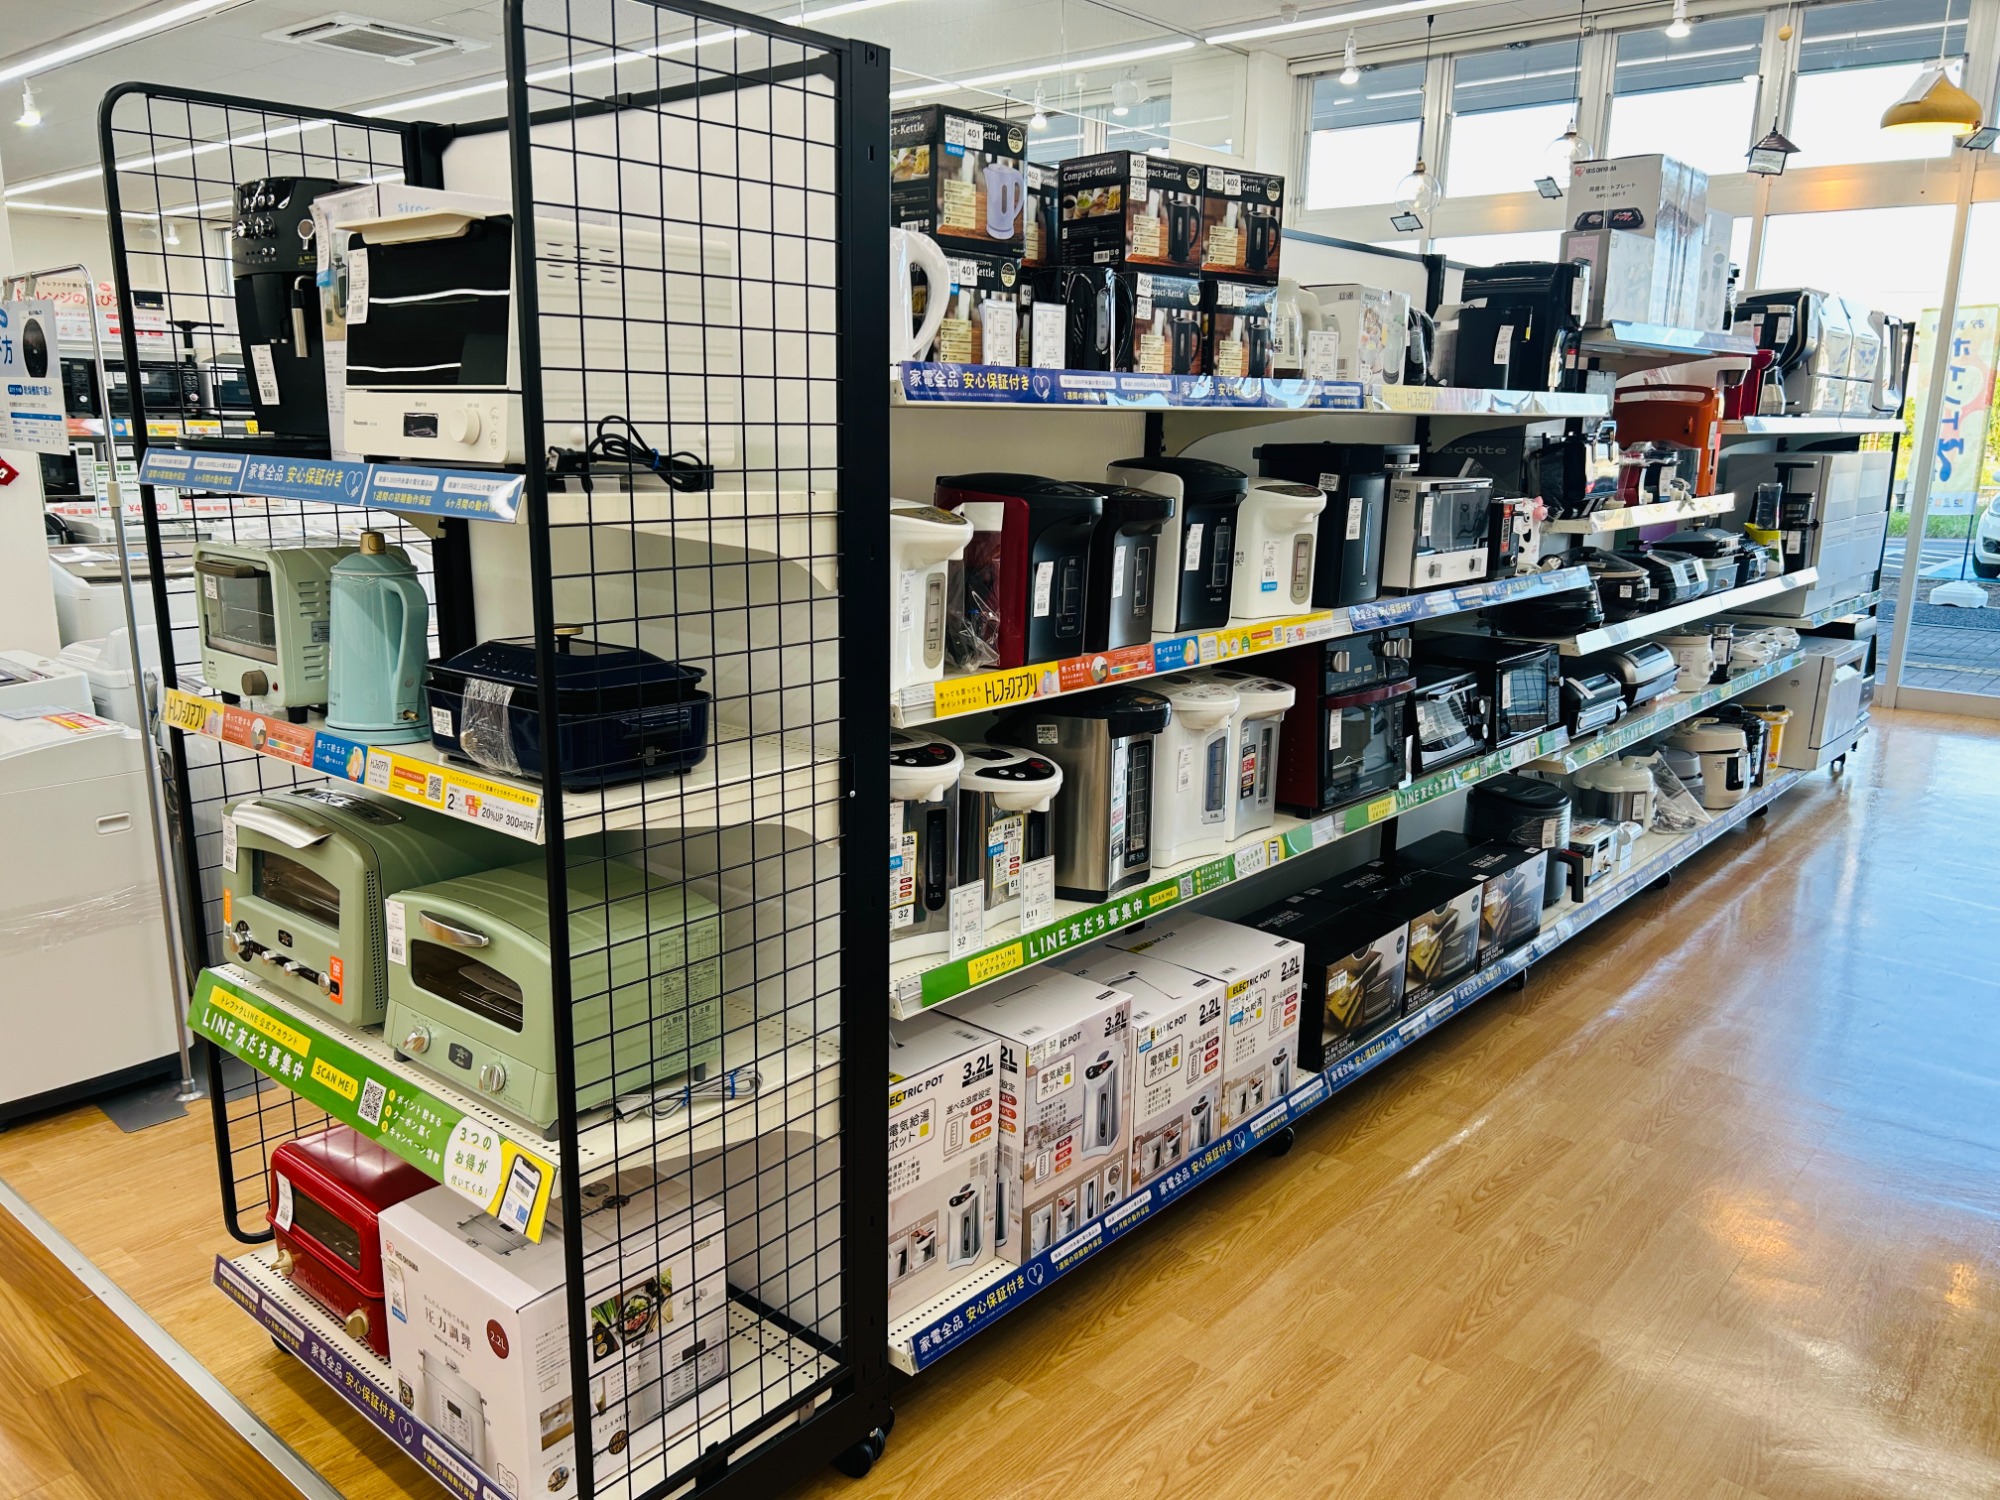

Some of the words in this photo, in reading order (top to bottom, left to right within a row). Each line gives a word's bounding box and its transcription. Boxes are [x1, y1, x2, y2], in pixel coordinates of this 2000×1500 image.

[967, 128, 981, 139] 401
[1063, 165, 1118, 182] Compact-Kettle
[1132, 159, 1145, 169] 402
[1226, 178, 1239, 187] 402
[961, 265, 976, 276] 401
[1139, 277, 1151, 289] 402
[909, 369, 959, 388] 家電全品
[963, 372, 1030, 390] 安心保証付き
[248, 463, 284, 482] 家電全品
[286, 466, 344, 488] 安心保証付き
[985, 671, 1038, 705] トレファクアプリ
[168, 697, 207, 729] トレファクアプリ
[481, 806, 504, 824] 20%UP
[898, 909, 909, 919] 32
[1026, 909, 1038, 919] 611
[957, 936, 967, 947] 32
[1281, 956, 1300, 976] 2.2L
[1232, 975, 1259, 995] ELECTRIC
[1260, 969, 1271, 981] POT
[1199, 997, 1220, 1020] 2.2L
[1104, 1010, 1127, 1031] 3.2L
[1174, 1013, 1187, 1027] POT
[1049, 1040, 1057, 1049] 32
[1068, 1031, 1081, 1046] POT
[315, 1064, 337, 1083] SCAN
[963, 1053, 994, 1080] 3.2L
[925, 1074, 944, 1090] POT
[946, 1087, 992, 1116] 選べる温度設定
[455, 1151, 489, 1174] お得が
[1158, 1168, 1191, 1196] 家電全品
[1191, 1140, 1233, 1176] 安心保証付き
[918, 1314, 964, 1353] 家電全品
[965, 1275, 1025, 1323] 安心保証付き
[490, 1331, 506, 1350] 2.2L
[345, 1371, 396, 1424] 安心保証付き
